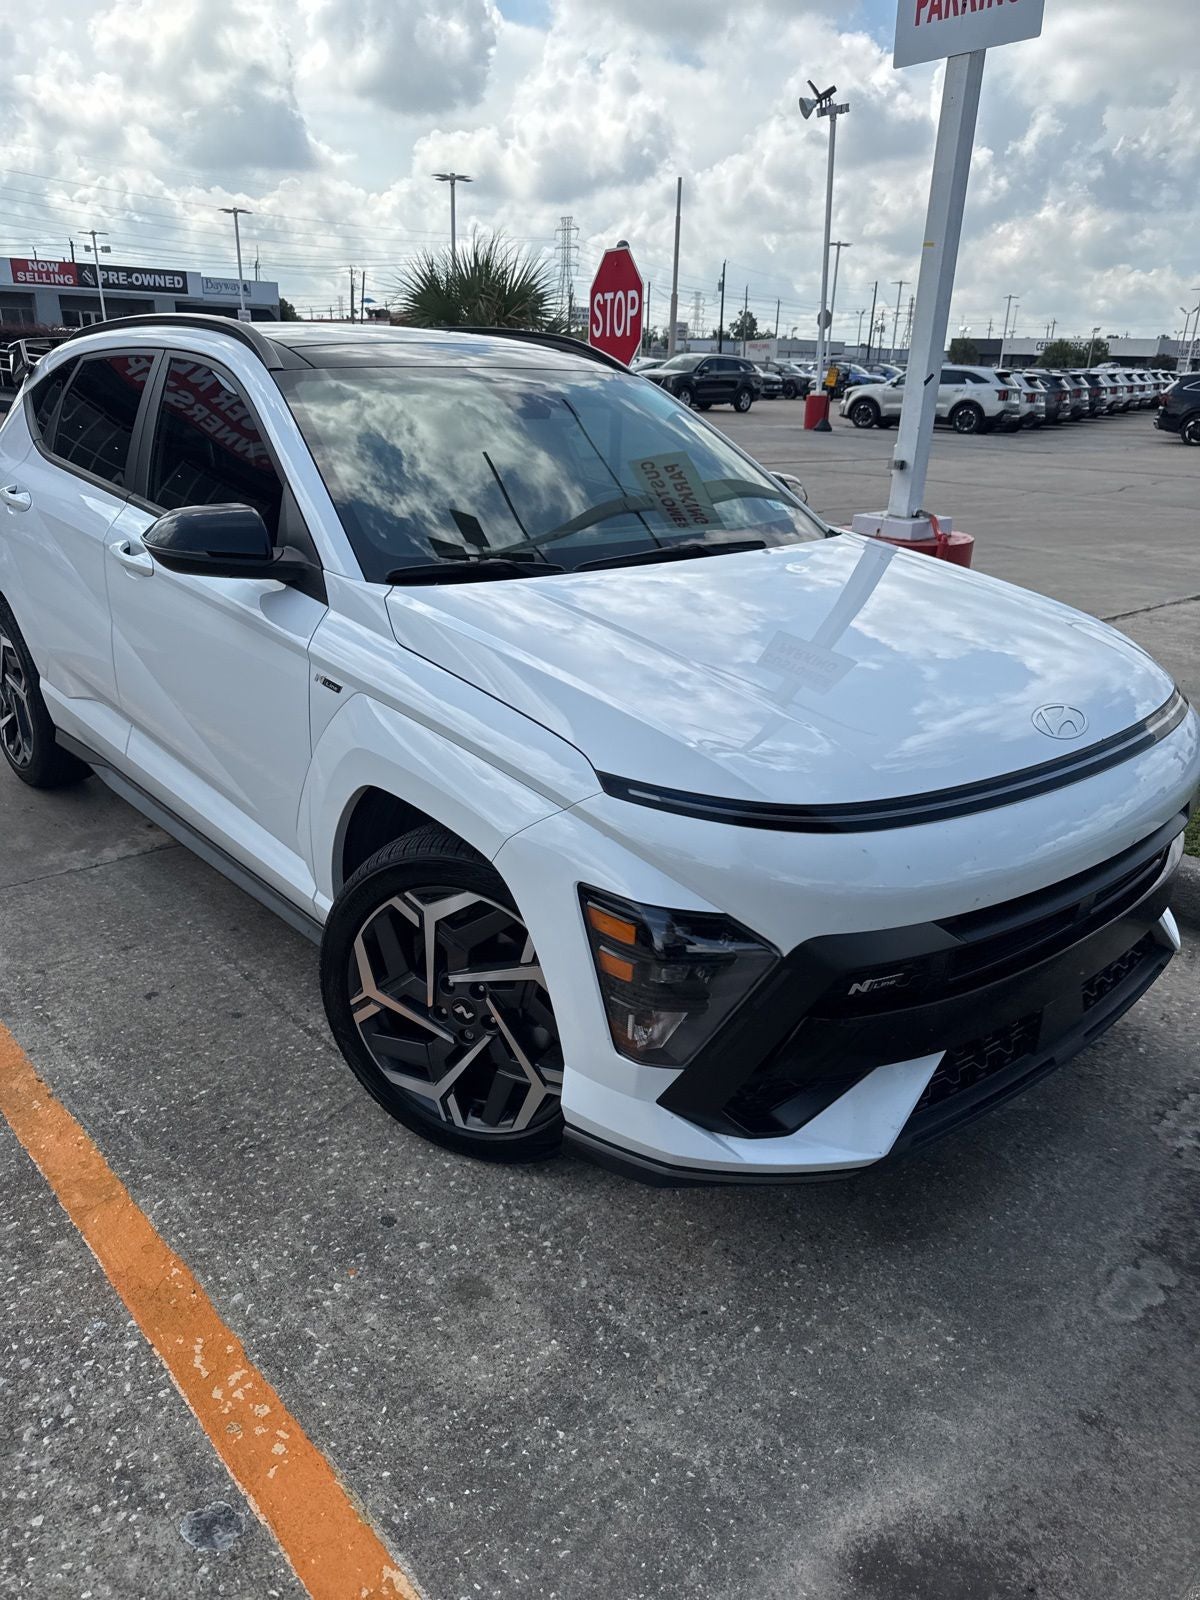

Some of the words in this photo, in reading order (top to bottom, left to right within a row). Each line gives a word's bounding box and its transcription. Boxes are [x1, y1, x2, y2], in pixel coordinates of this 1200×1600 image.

[28, 261, 59, 272] NOW
[17, 272, 74, 284] SELLING
[99, 270, 184, 289] PRE-OWNED
[592, 289, 639, 338] STOP
